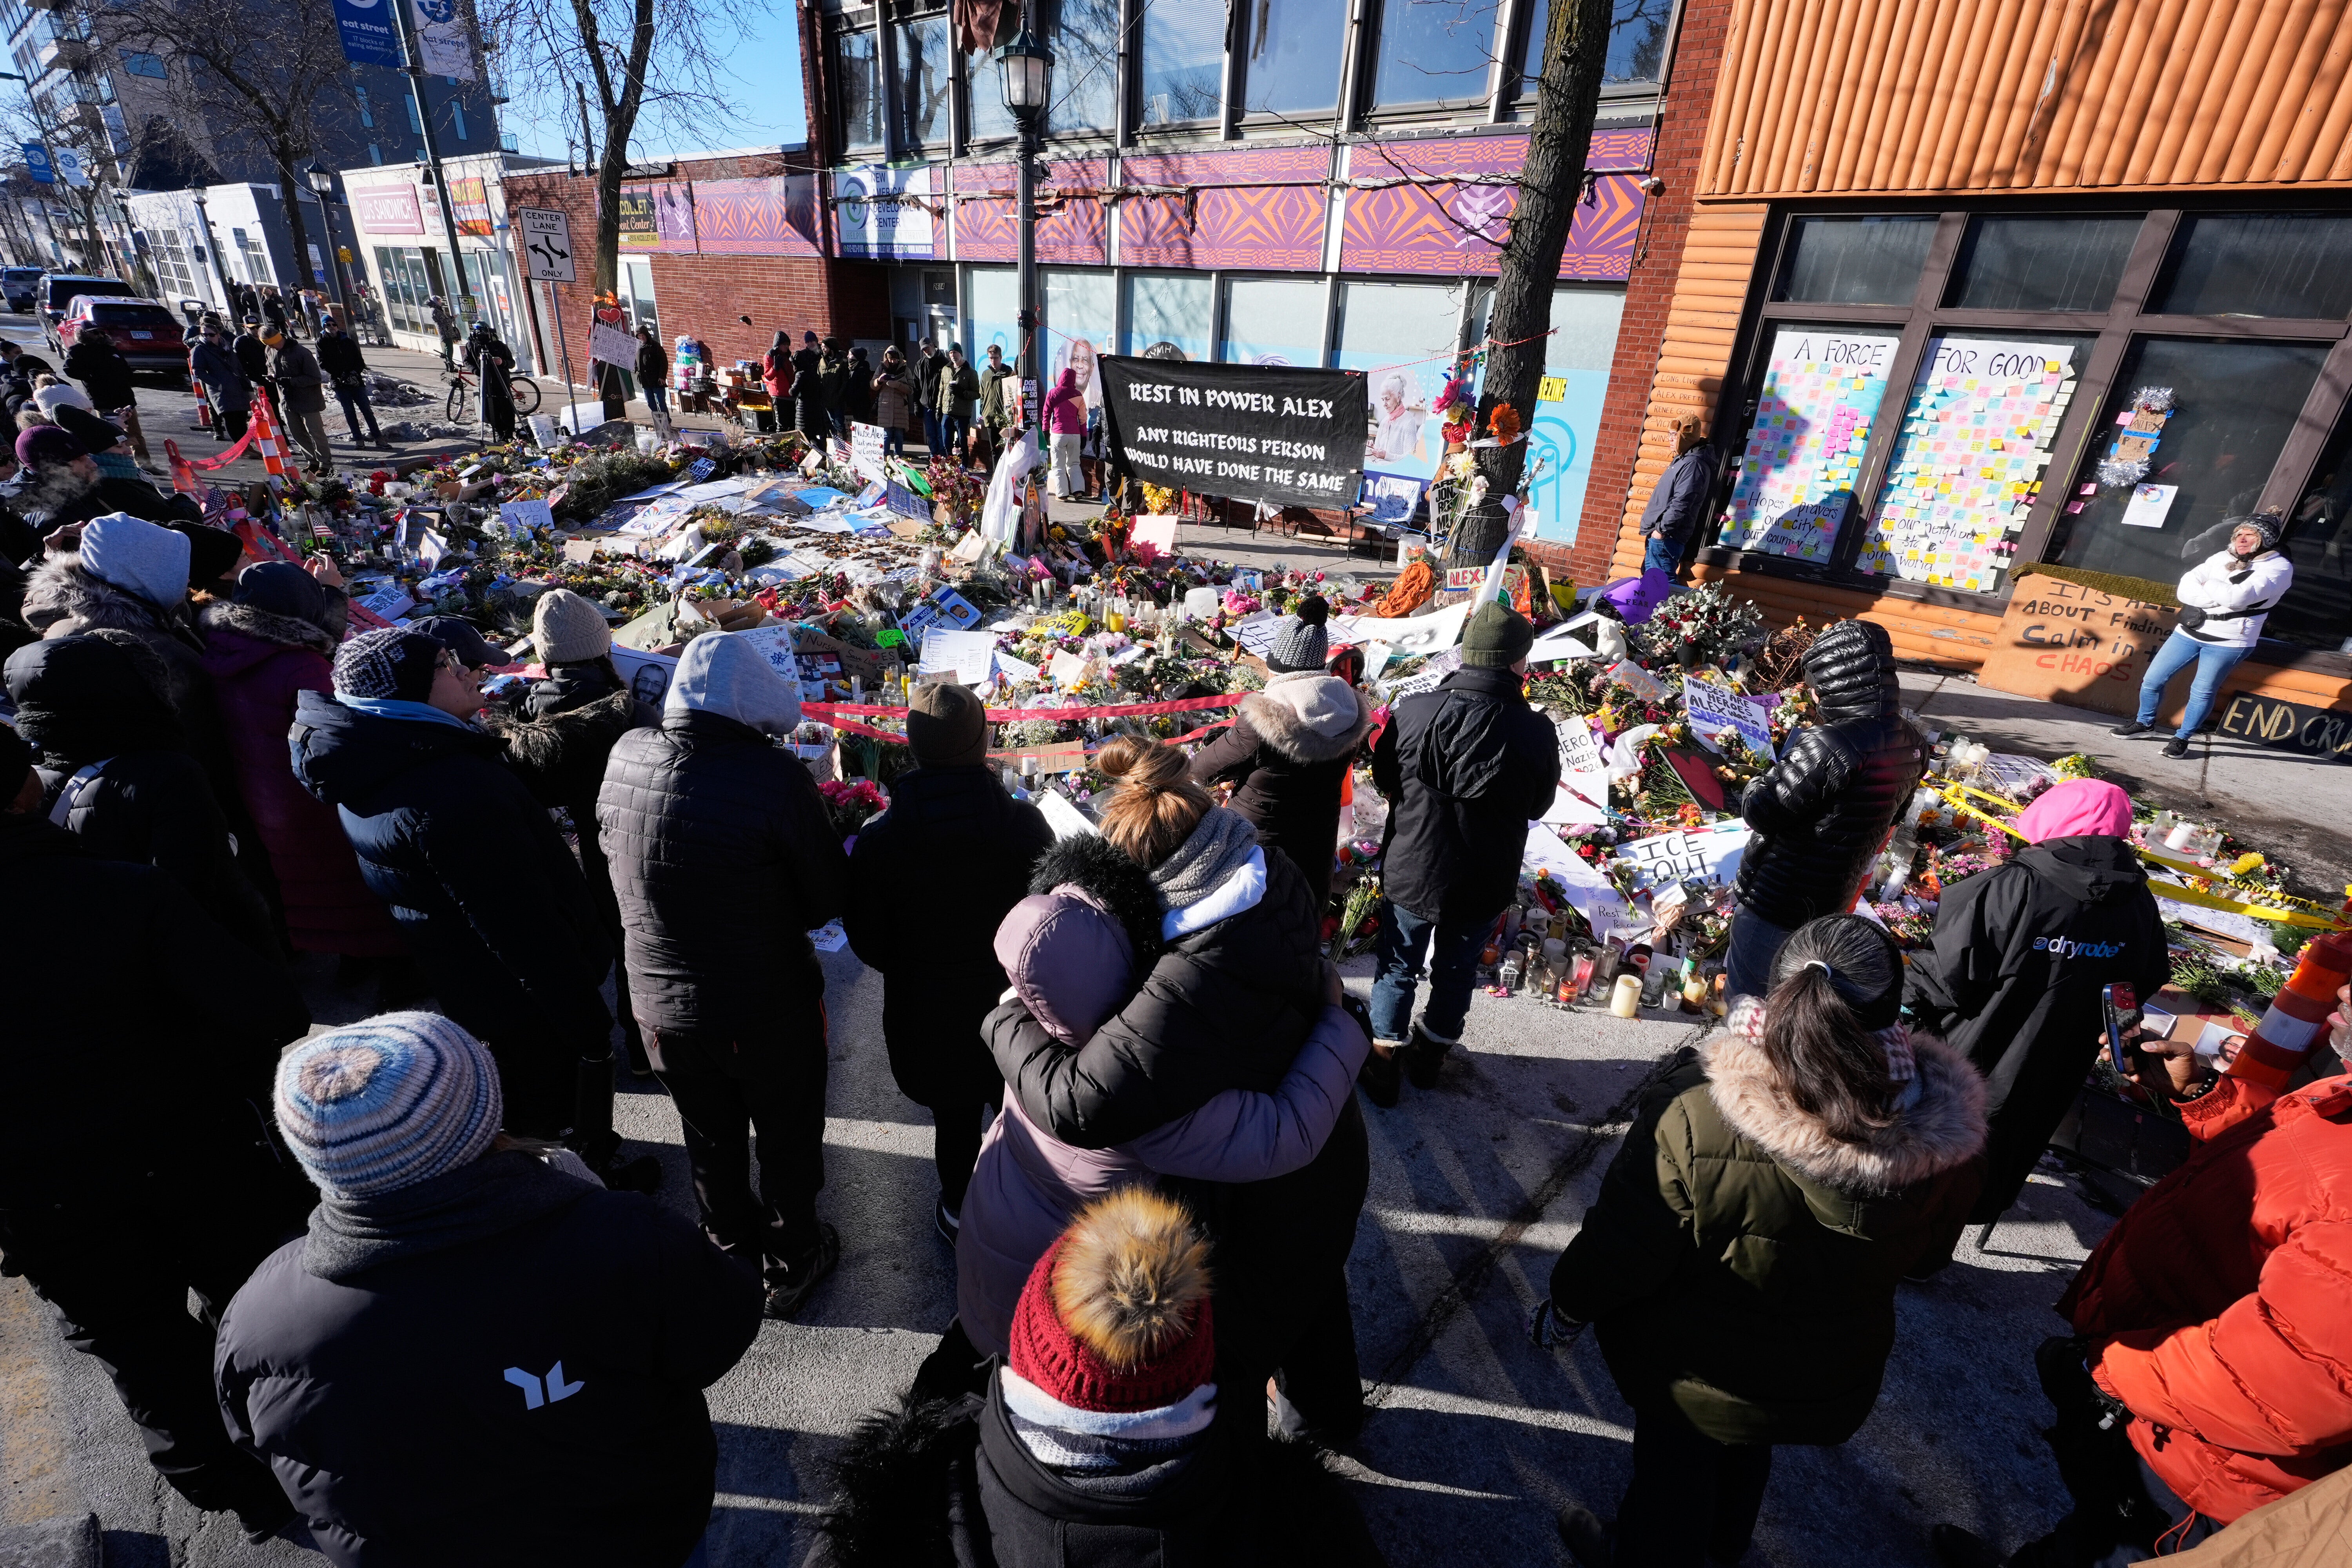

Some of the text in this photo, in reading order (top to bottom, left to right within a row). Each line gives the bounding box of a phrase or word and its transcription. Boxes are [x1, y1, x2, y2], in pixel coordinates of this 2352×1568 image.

[342, 20, 389, 34] eat street
[348, 42, 365, 50] eating
[359, 37, 377, 45] blocks
[439, 37, 466, 48] street
[871, 172, 886, 183] NEW
[873, 187, 907, 196] AMERICAN
[361, 198, 414, 220] LU's SANDWICH
[620, 199, 647, 216] COLLET
[526, 212, 561, 222] CENTER
[630, 216, 650, 230] Center
[874, 218, 901, 227] CENTER
[533, 221, 557, 230] LANE
[460, 303, 476, 312] OUT!
[641, 316, 656, 325] Parking
[602, 327, 622, 342] HMONG
[593, 342, 629, 361] HEALERS AND
[599, 336, 625, 352] CHRISTIAN
[627, 346, 637, 356] FOR
[1794, 338, 2046, 379] A FORCE FOR GOOD
[1661, 374, 1697, 385] LONG LIVE
[1128, 382, 1333, 419] REST IN POWER ALEX
[1657, 390, 1703, 402] ALEX PRETTI
[1654, 405, 1673, 415] RENEE
[1656, 419, 1670, 428] VICT
[2129, 419, 2164, 432] ALEX
[855, 425, 870, 438] Nurse
[870, 427, 884, 439] Alex
[1651, 434, 1670, 442] WINS
[853, 436, 865, 446] Thank
[1136, 426, 1325, 461] ANY RIGHTEOUS PERSON
[1123, 446, 1169, 470] WOULD
[1172, 456, 1213, 477] HAVE
[1217, 461, 1260, 482] DONE
[1263, 466, 1292, 485] THE
[1296, 472, 1347, 492] SAME
[1436, 486, 1454, 503] JON
[503, 501, 548, 515] ABOLISH
[657, 498, 691, 508] TOGETHER
[1748, 491, 1784, 510] Hopes
[1798, 501, 1838, 520] prayers
[1765, 515, 1818, 536] our city,
[1898, 518, 1921, 530] our
[1742, 529, 1762, 540] our
[1874, 533, 1896, 543] our
[1867, 550, 1892, 561] our
[1449, 568, 1481, 587] ALEX
[1625, 598, 1649, 608] FEAR
[919, 606, 931, 618] HOSP
[1061, 614, 1083, 624] OUT
[1036, 620, 1076, 633] NOW!
[2022, 599, 2173, 642] ABOUT Finding
[806, 633, 841, 653] Nurses
[2022, 625, 2135, 657] Calm in
[846, 649, 862, 662] Save
[968, 649, 981, 675] ACTION!
[2036, 654, 2133, 682] CHAOS
[1385, 673, 1439, 691] NURSES
[1408, 681, 1432, 692] FOR
[1687, 678, 1750, 708] NURSES ARE
[1690, 694, 1727, 716] ALEX
[1727, 710, 1749, 722] was
[1707, 693, 1753, 717] HEROES
[1688, 706, 1771, 744] SUPERHERO
[2223, 697, 2295, 740] END
[1556, 724, 1564, 736] I
[1558, 734, 1588, 755] HERO
[1566, 750, 1596, 768] Nazis
[813, 755, 833, 779] LEX
[1638, 834, 1706, 862] ICE
[1890, 851, 1905, 862] Rest
[1653, 851, 1708, 879] OUT
[1598, 906, 1620, 918] Rest
[2048, 936, 2119, 959] dryrobe
